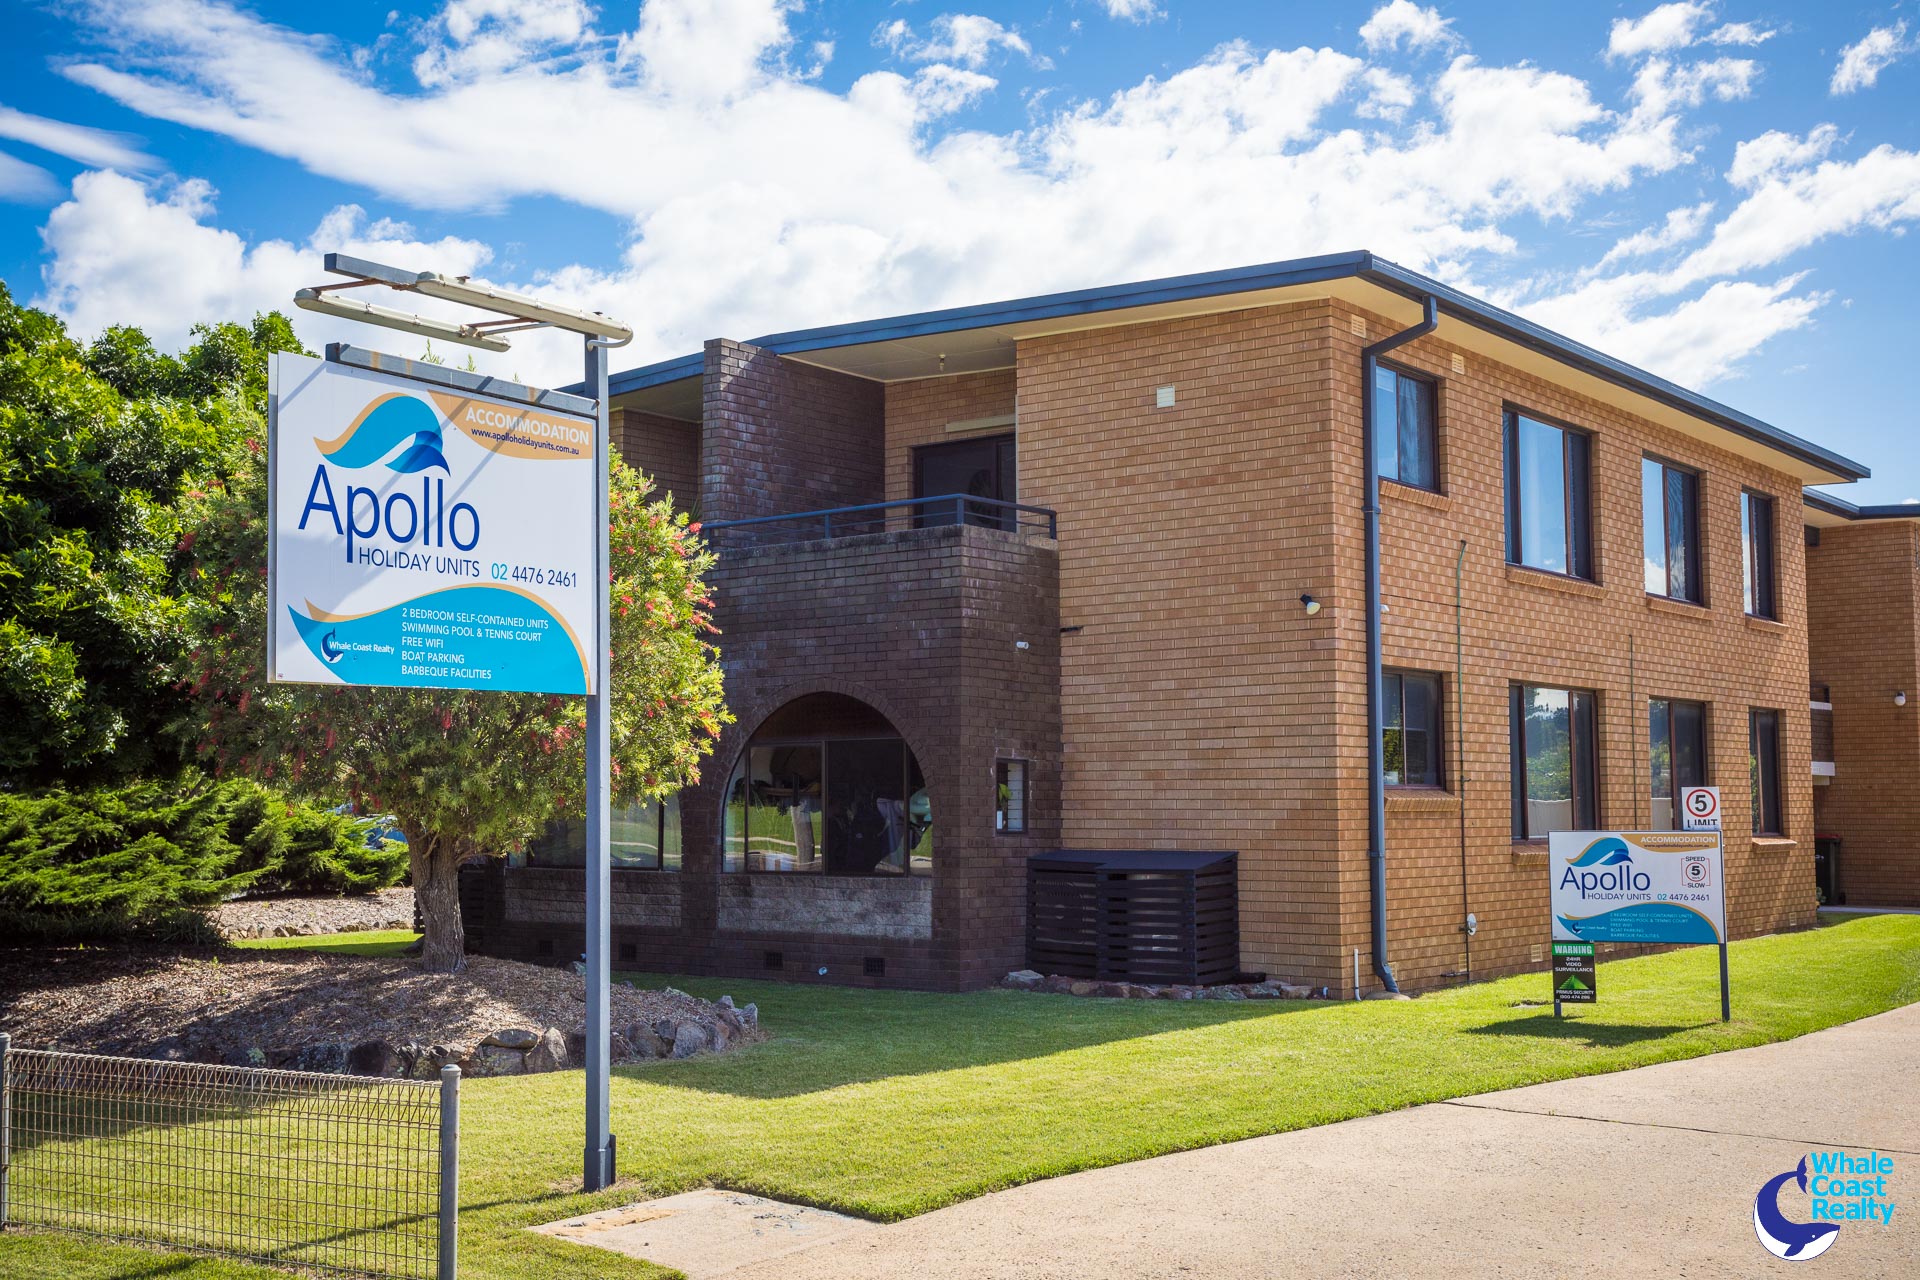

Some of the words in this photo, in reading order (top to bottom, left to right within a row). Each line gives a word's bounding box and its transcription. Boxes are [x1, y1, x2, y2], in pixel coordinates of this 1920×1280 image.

[465, 406, 590, 446] ACCOMMODATION
[471, 428, 580, 455] www.apolloholidayunits.com.au
[298, 464, 480, 563] Apollo
[359, 547, 431, 571] HOLIDAY
[436, 556, 480, 577] UNITS
[491, 562, 508, 580] 02
[512, 566, 544, 584] 4476
[548, 569, 577, 587] 2461
[402, 608, 408, 618] 2
[410, 608, 454, 621] BEDROOM
[456, 612, 524, 628] SELF-CONTAINED
[526, 619, 549, 630] UNITS
[402, 622, 450, 634] SWIMMING
[452, 626, 474, 637] POOL
[476, 628, 482, 638] &
[485, 628, 514, 640] TENNIS
[516, 630, 542, 642] COURT
[329, 641, 352, 650] Whale
[352, 642, 372, 652] Coast
[373, 644, 394, 654] Realty
[402, 636, 422, 647] FREE
[426, 638, 444, 648] WIFI
[402, 650, 425, 661] BOAT
[428, 652, 464, 664] PARKING
[402, 665, 448, 676] BARBEQUE
[450, 668, 492, 680] FACILITIES
[1694, 794, 1708, 812] 5
[1687, 819, 1718, 828] LIMIT
[1691, 865, 1701, 876] 5
[1560, 865, 1651, 899] Apollo
[1554, 945, 1592, 954] WARNING
